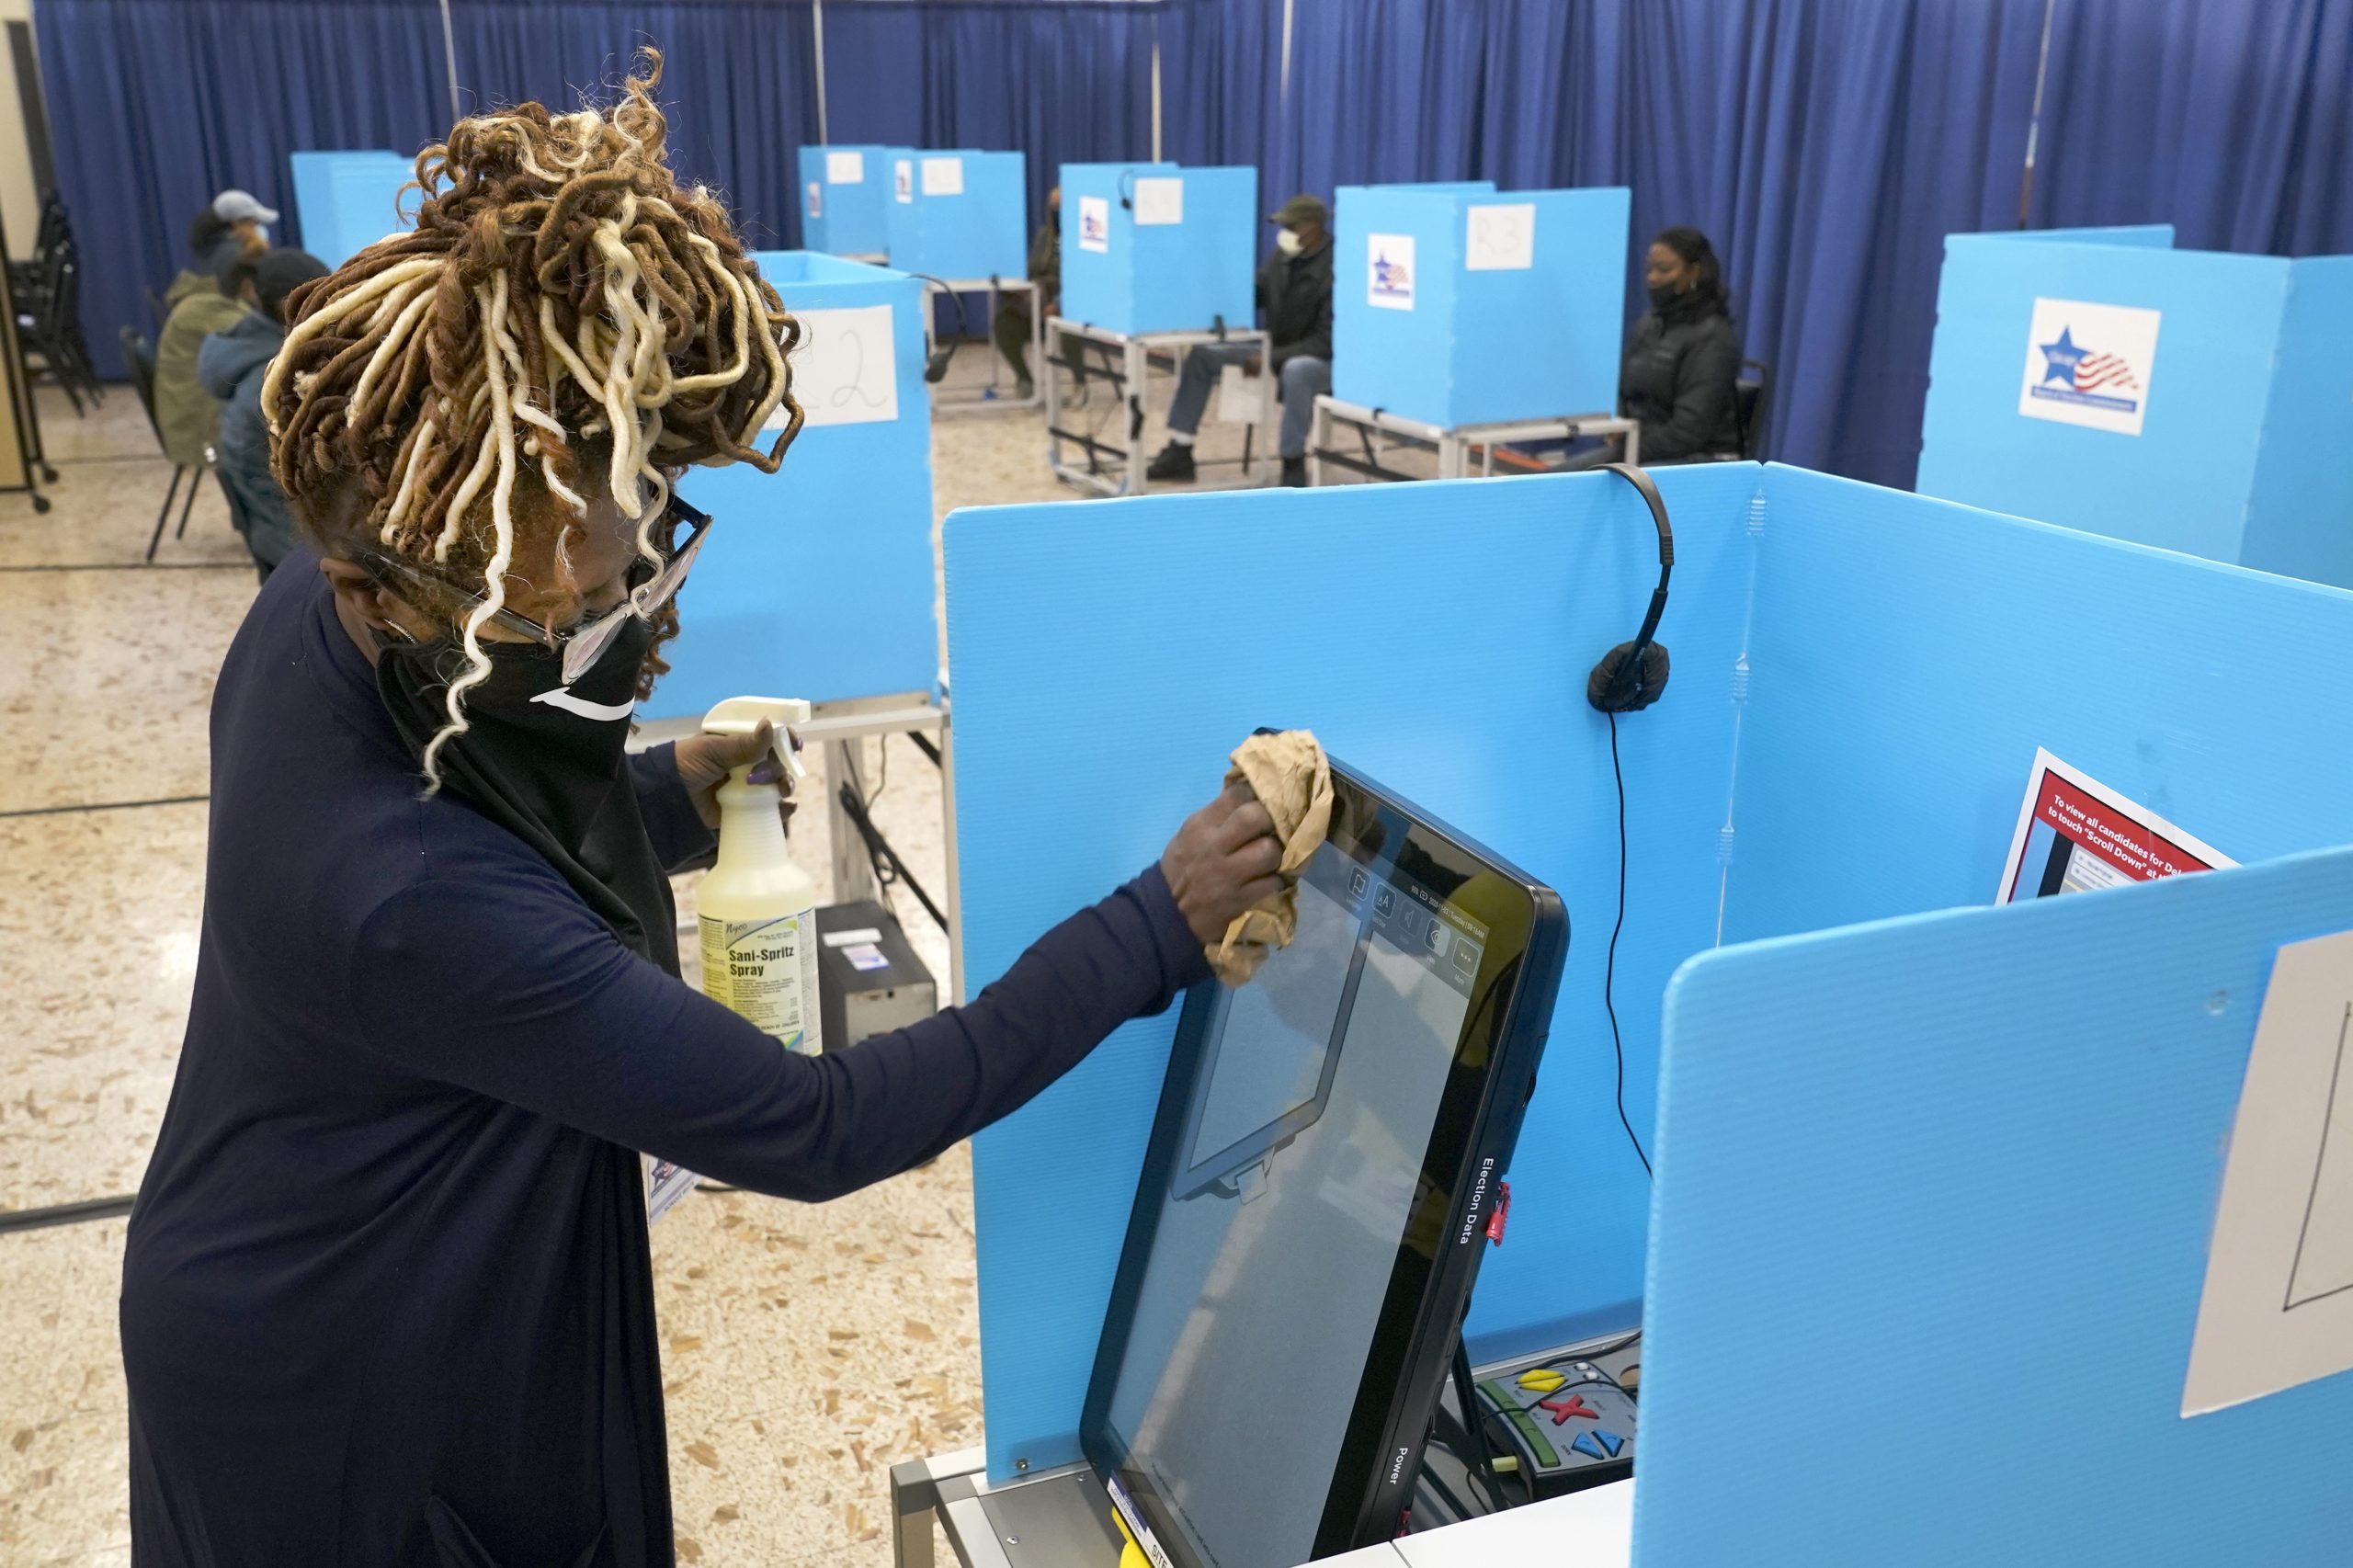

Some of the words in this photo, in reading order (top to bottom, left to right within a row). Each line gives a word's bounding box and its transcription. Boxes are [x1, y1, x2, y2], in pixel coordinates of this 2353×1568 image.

[2048, 805, 2058, 818] to
[2058, 812, 2083, 835] touch
[2146, 868, 2157, 880] at
[2054, 794, 2064, 808] To
[2065, 803, 2086, 821] view
[2086, 817, 2098, 829] all
[2098, 824, 2149, 858] candidates
[2149, 852, 2165, 868] for
[729, 946, 794, 962] Sani-Spritz
[730, 963, 764, 977] Spray
[1470, 1158, 1494, 1210] Election
[1460, 1214, 1477, 1244] Data
[1389, 1448, 1408, 1485] Power
